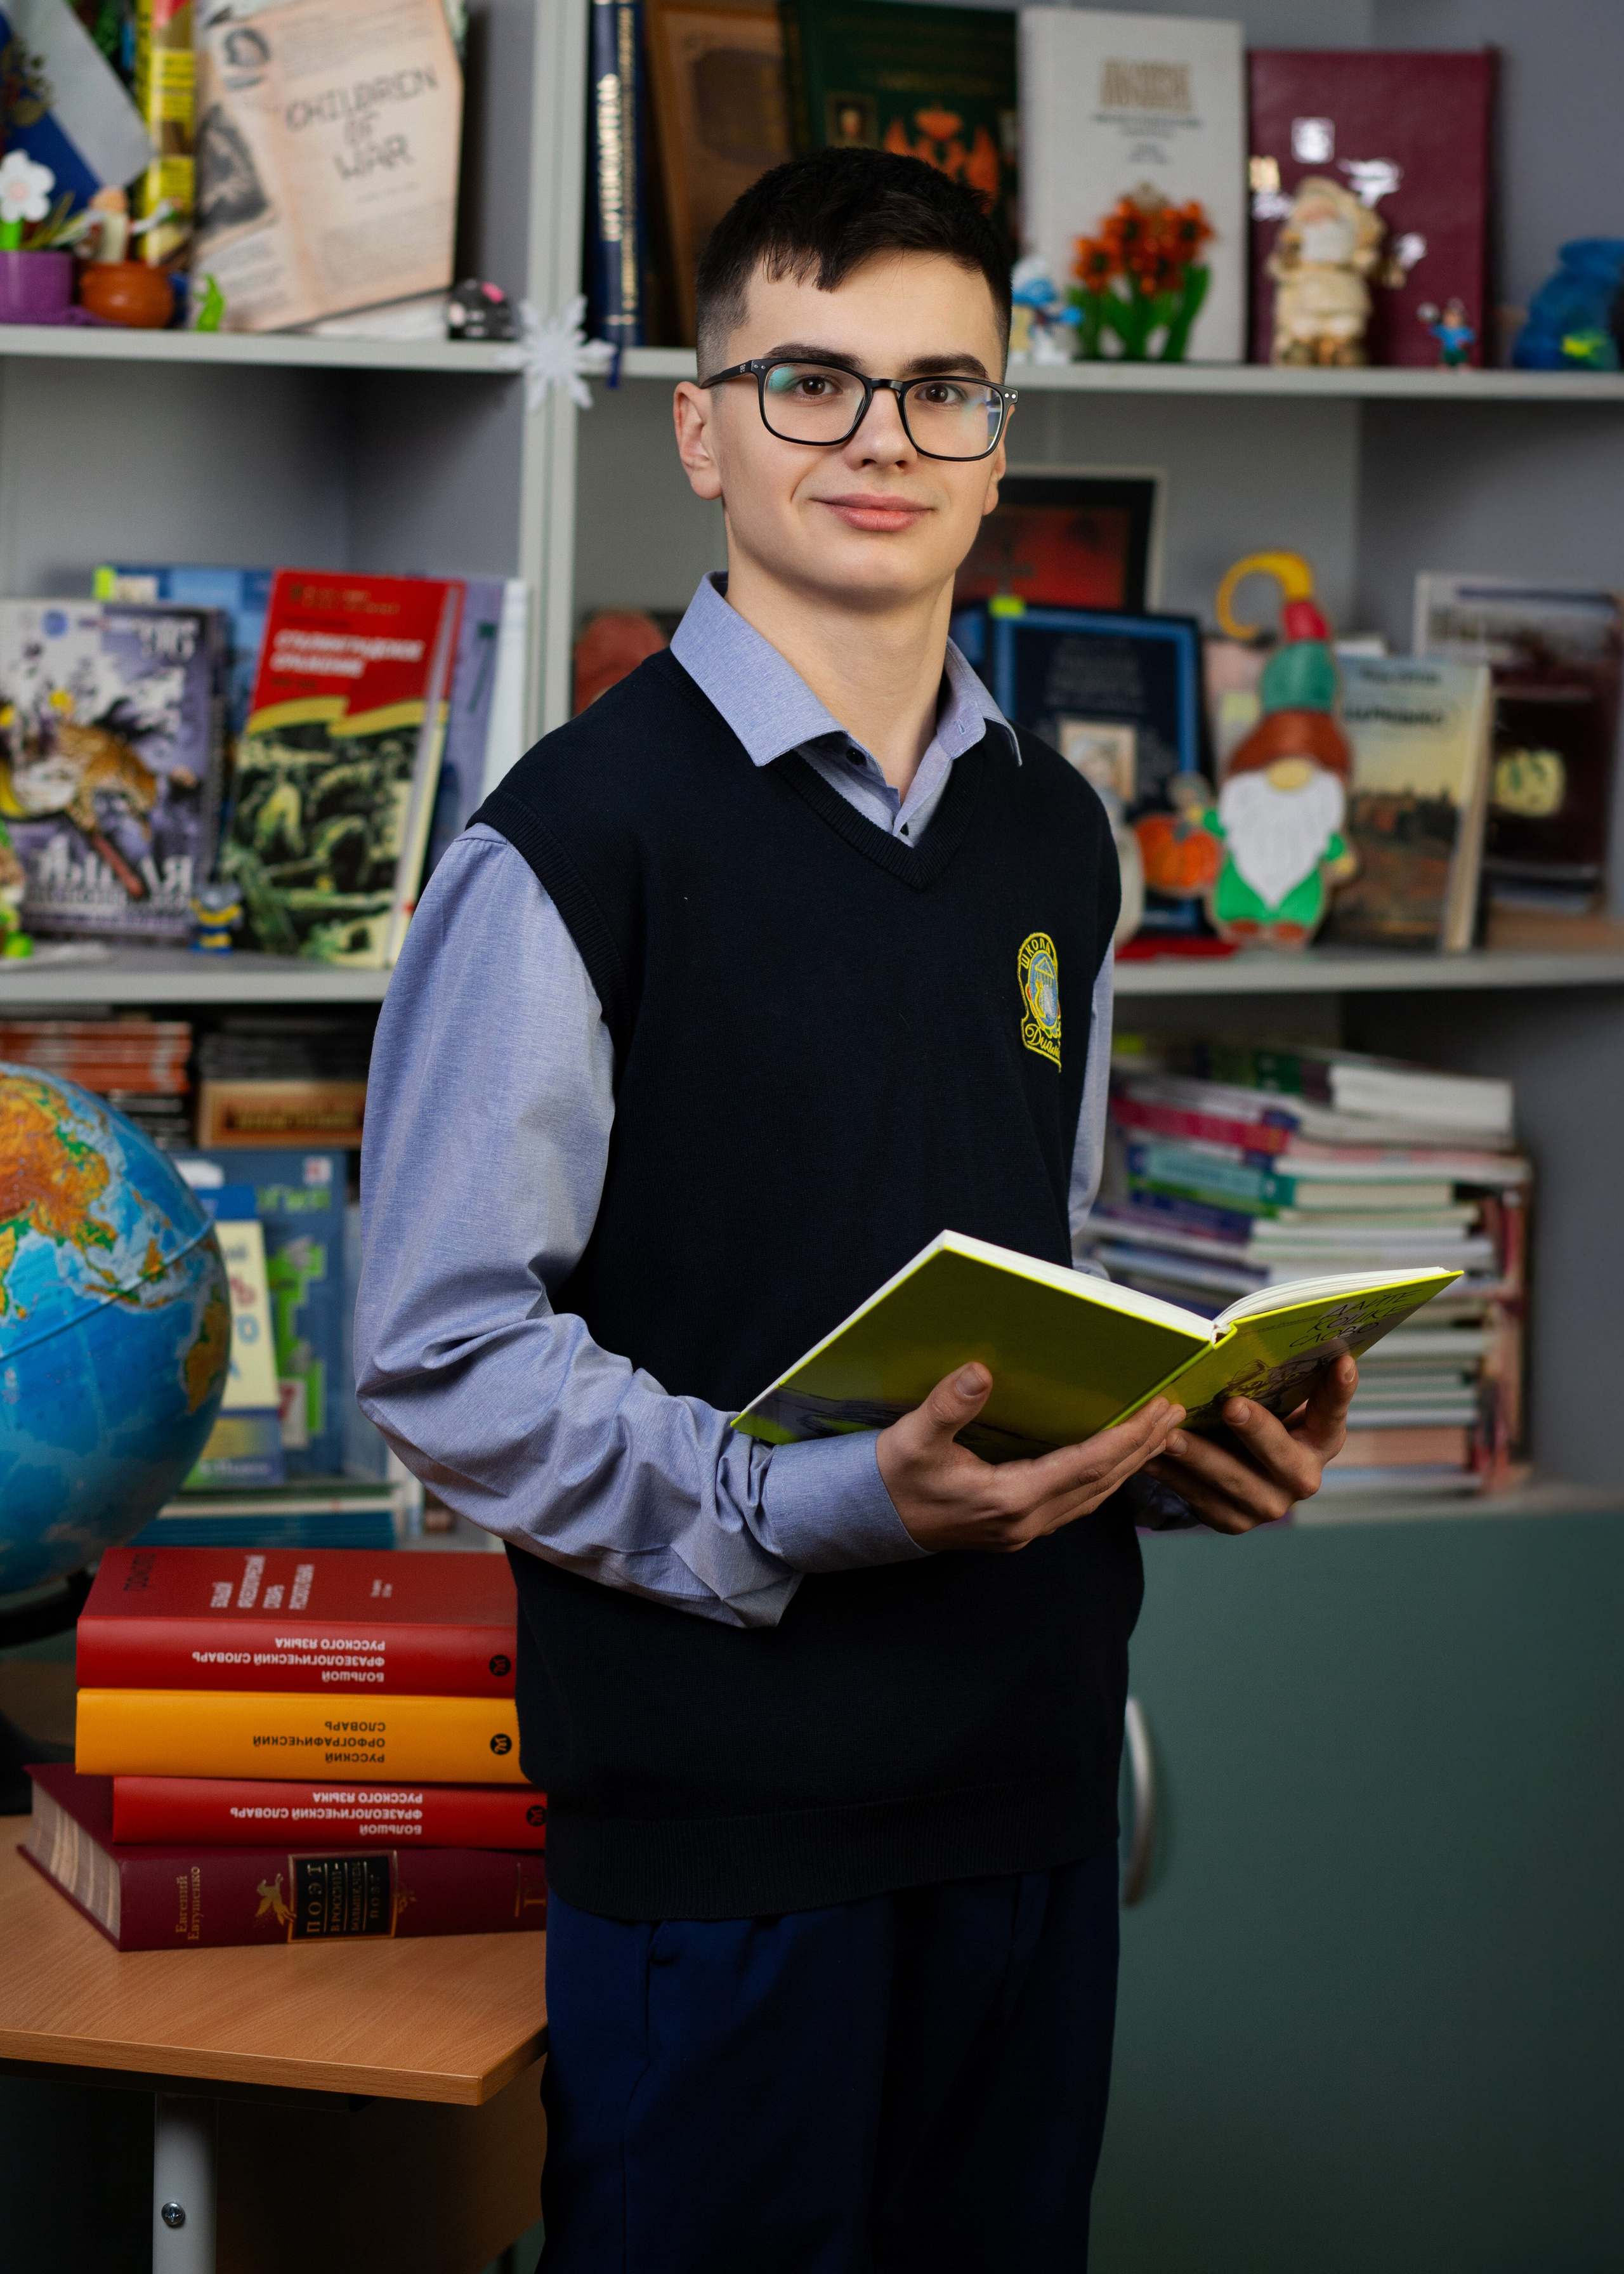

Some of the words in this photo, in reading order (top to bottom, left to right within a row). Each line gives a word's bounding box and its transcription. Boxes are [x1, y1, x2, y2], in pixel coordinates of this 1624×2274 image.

[285, 65, 438, 131] CHILDREN
[334, 134, 416, 181] WAR
[1021, 938, 1051, 969] ШКОЛА
[1321, 1289, 1422, 1321] ДАЙТЕ
[1307, 1303, 1412, 1333] КОШКЕ
[1289, 1322, 1379, 1347] СЛОВО
[275, 1638, 318, 1649] ЯЗЫКА
[320, 1638, 386, 1651] РУССКОГО
[192, 1652, 251, 1664] СЛОВАРЬ
[254, 1653, 385, 1667] ФРАЗЕОЛОГИЧЕСКИЙ
[322, 1671, 384, 1683] БОЛЬШОЙ
[325, 1721, 386, 1732] СЛОВАРЬ
[253, 1735, 385, 1748] ОРФОГРАФИЧЕСКИЙ
[325, 1752, 384, 1763] РУССКИЙ
[312, 1792, 356, 1803] ЯЗЫКА
[358, 1792, 423, 1804] РУССКОГО
[230, 1807, 289, 1819] СЛОВАРЬ
[291, 1808, 423, 1820] ФРАЗЕОЛОГИЧЕСКИЙ
[359, 1824, 422, 1836] БОЛЬШОЙ
[175, 1875, 188, 1933] Евгений
[187, 1866, 204, 1940] Евтушенко
[306, 1863, 322, 1933] ПОЭТ
